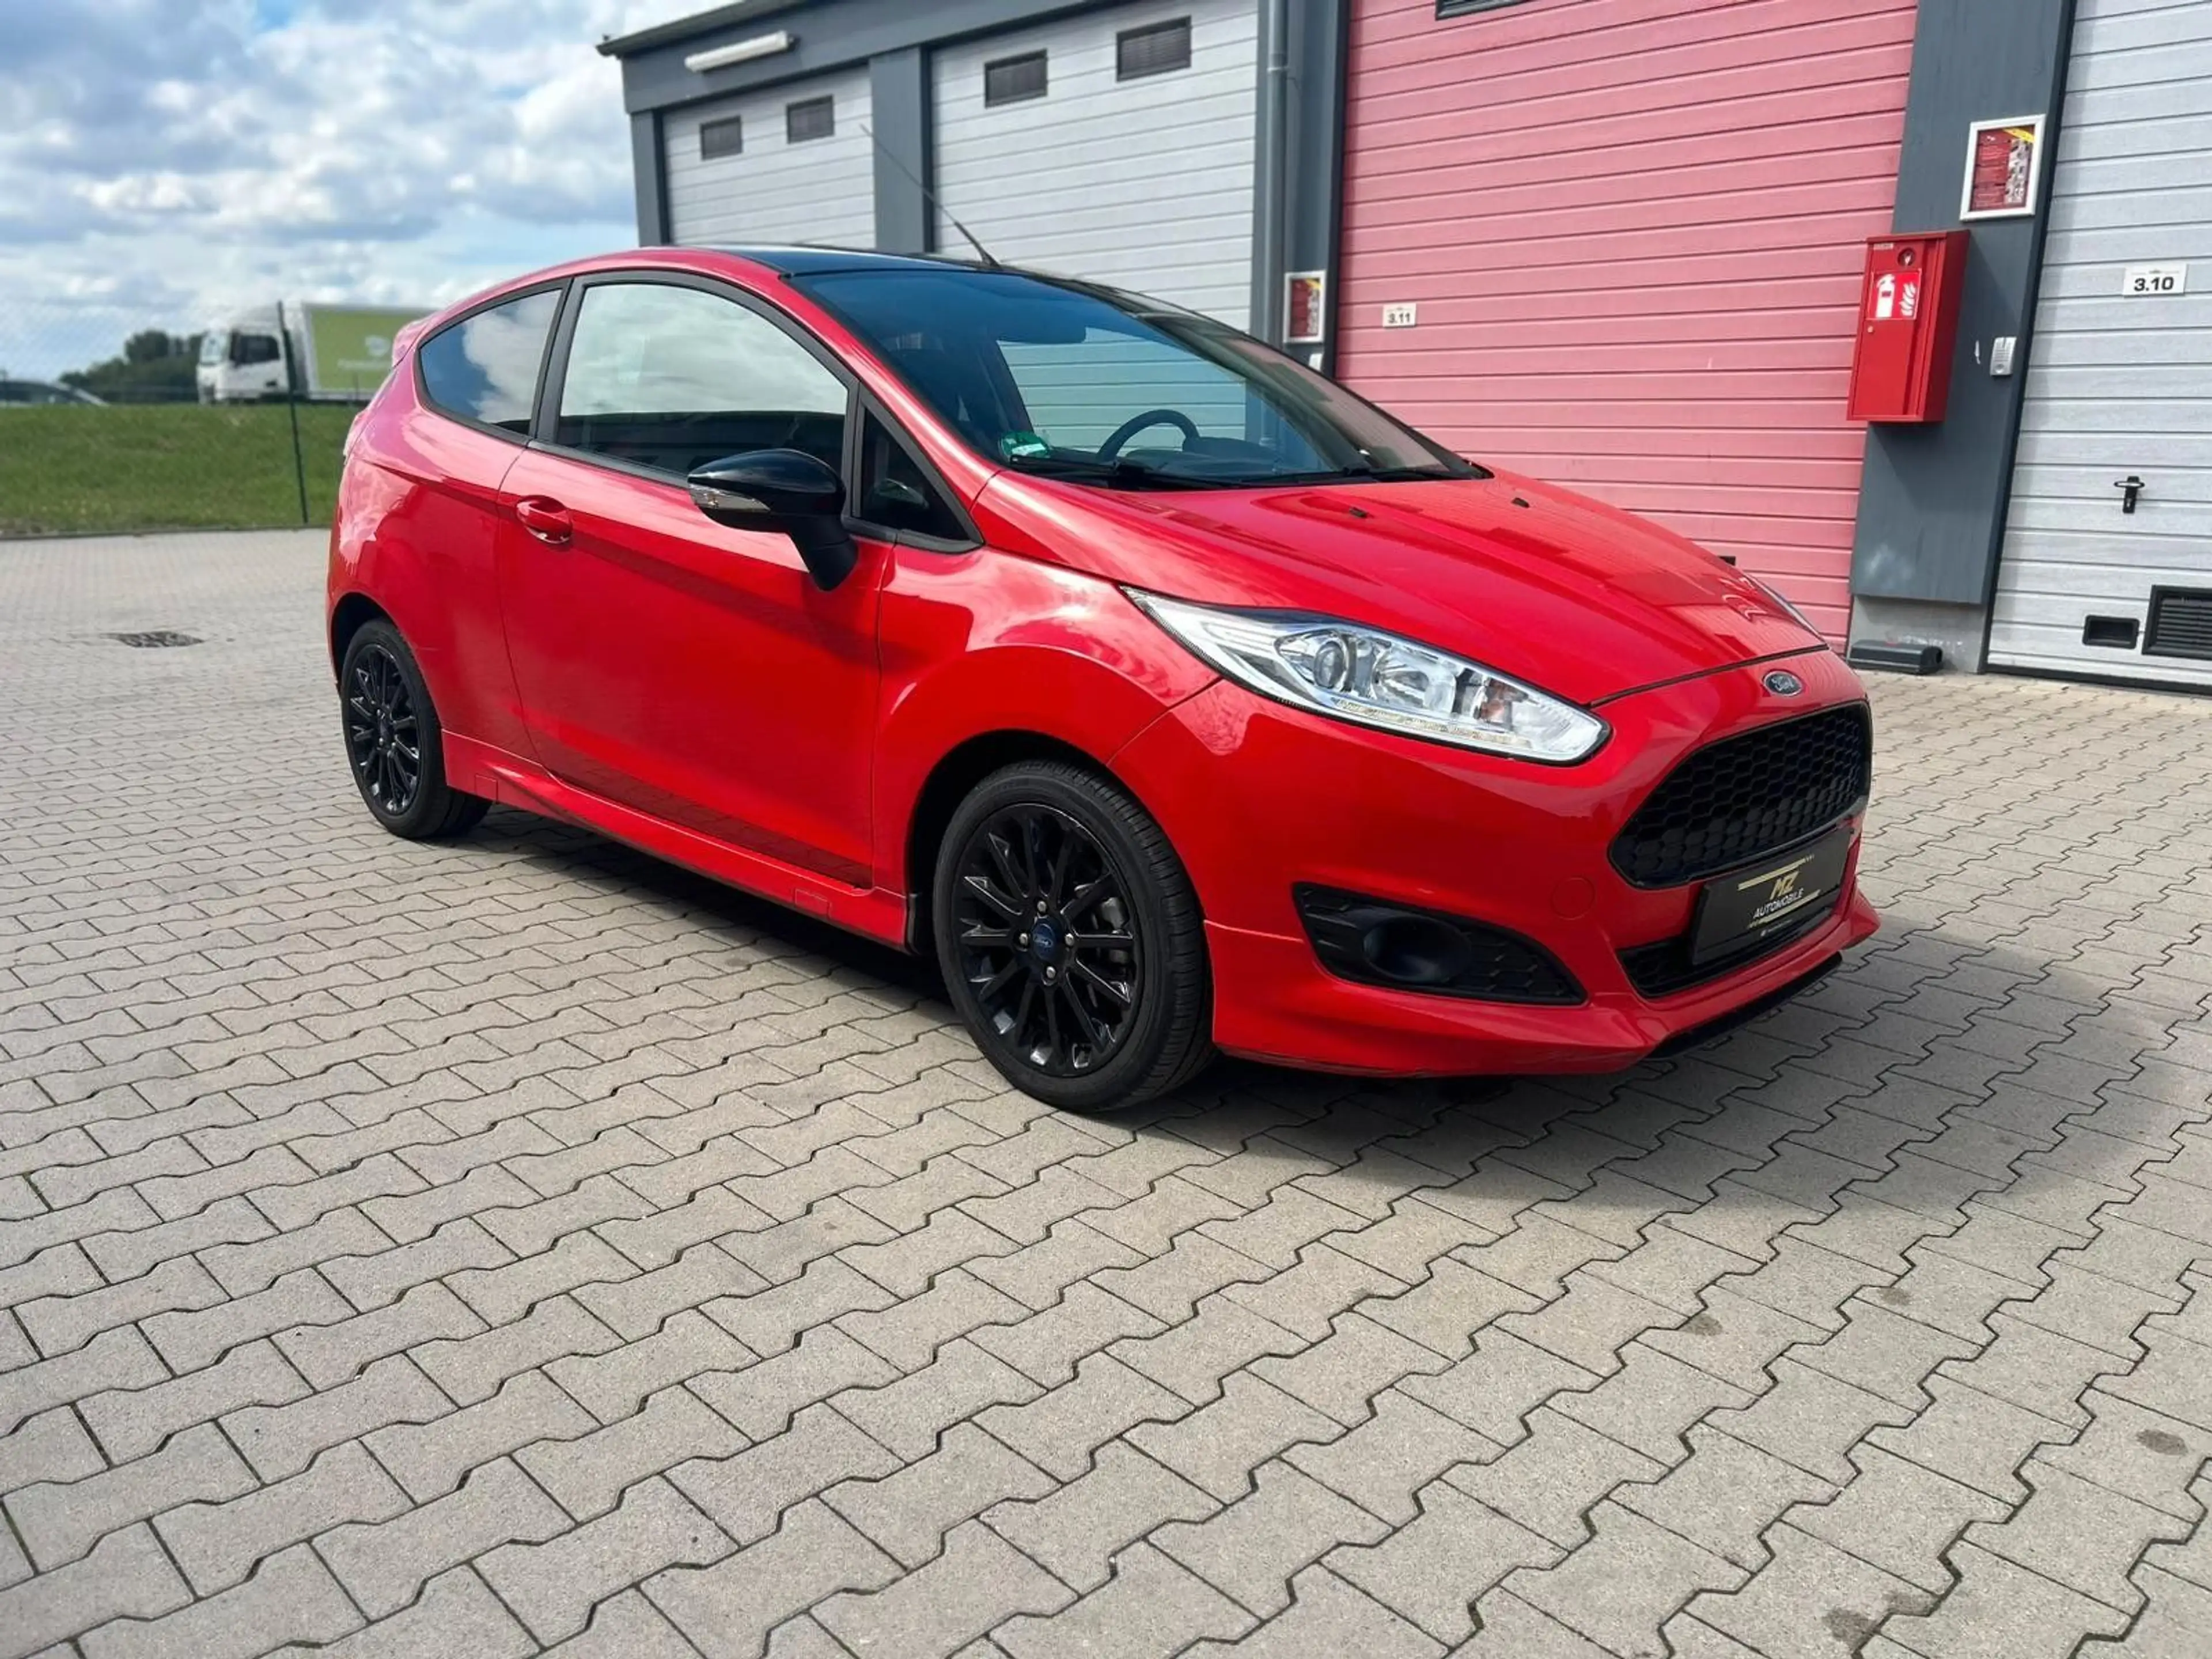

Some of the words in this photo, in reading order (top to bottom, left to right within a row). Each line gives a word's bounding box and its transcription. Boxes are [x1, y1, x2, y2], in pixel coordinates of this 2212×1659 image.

[2134, 276, 2175, 292] 3.10
[1387, 312, 1410, 324] 3.11
[1753, 888, 1804, 919] AUTOMOBILE
